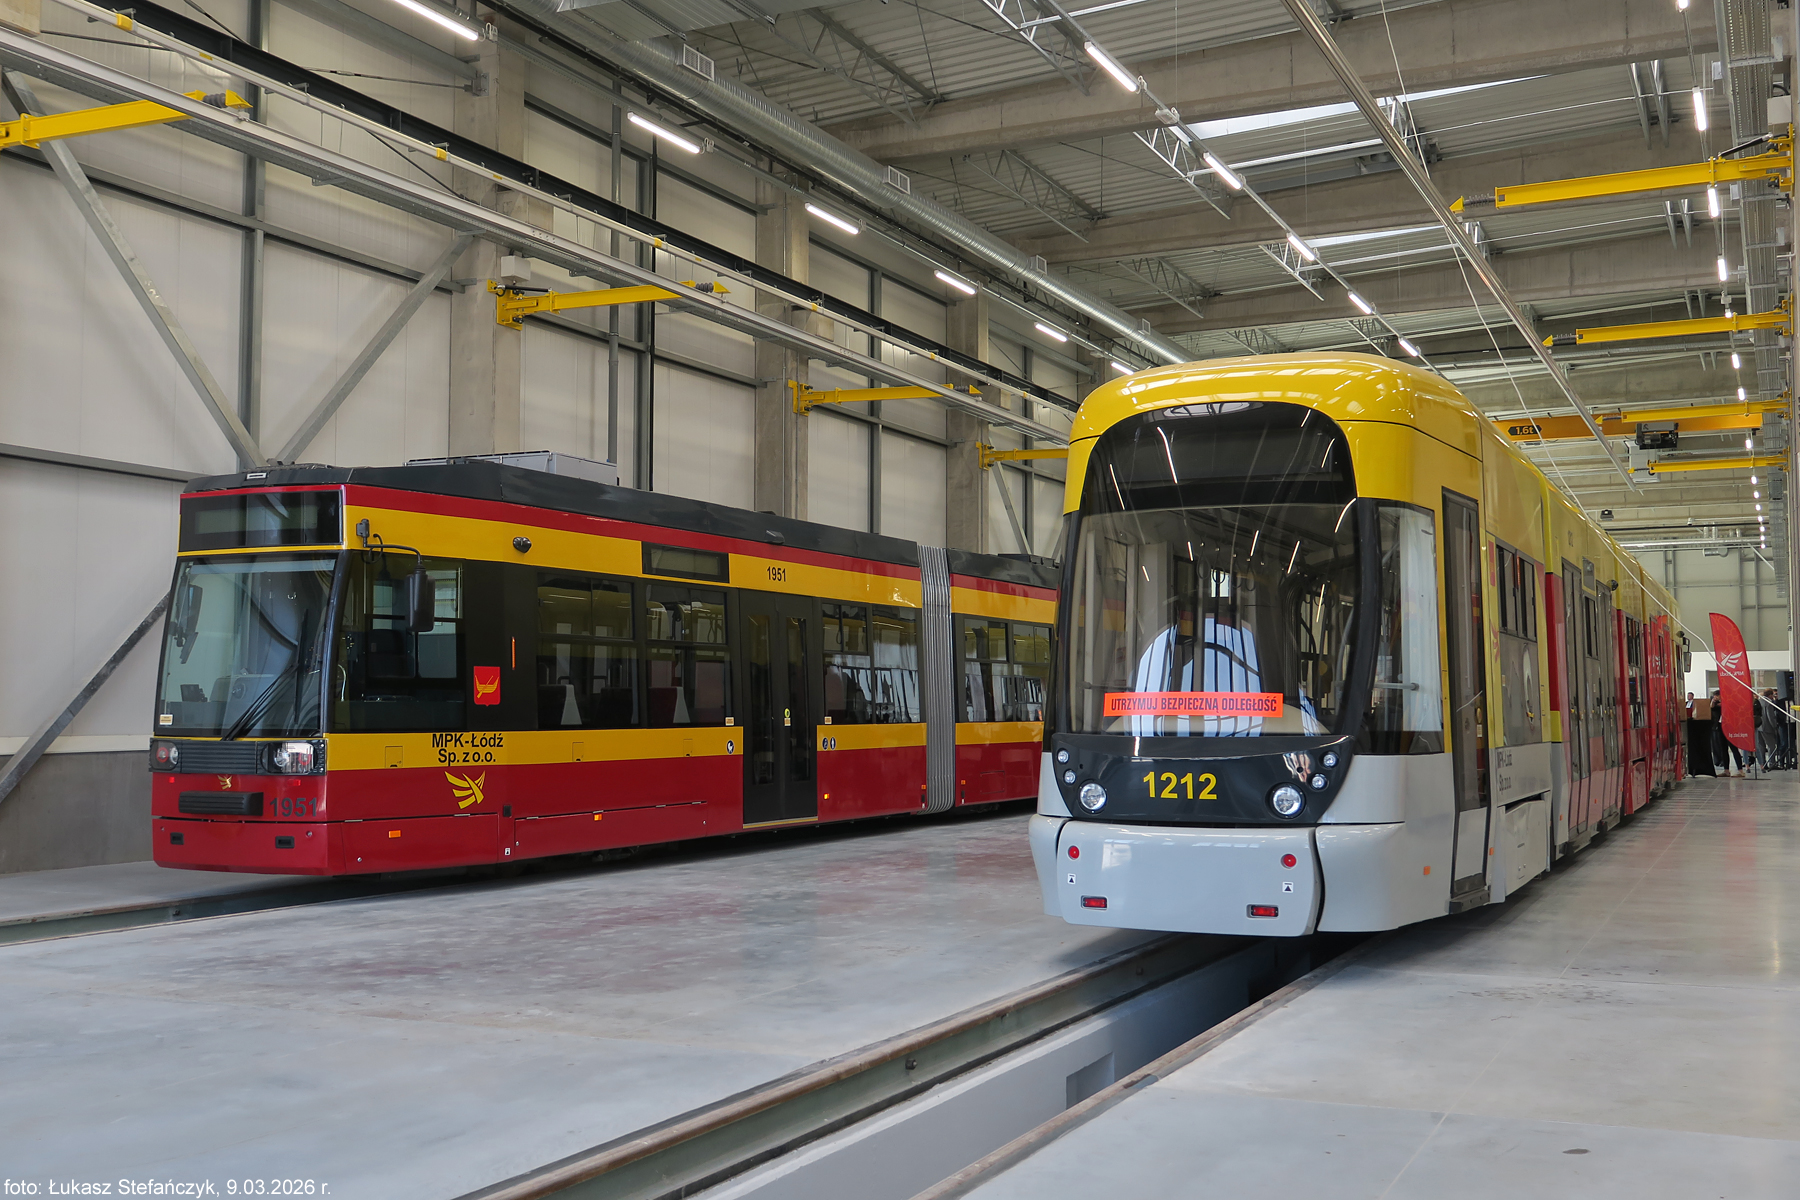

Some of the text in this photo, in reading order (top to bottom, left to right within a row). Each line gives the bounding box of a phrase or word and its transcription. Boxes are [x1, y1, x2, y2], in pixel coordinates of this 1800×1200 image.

[1515, 426, 1534, 435] 1,6t
[766, 566, 786, 582] 1951
[1111, 695, 1277, 714] UTRZYMUJ BEZPIECZNĄ ODLEGŁOŚĆ
[432, 733, 504, 748] MPK-Łódź
[438, 748, 460, 767] Sp.
[1143, 771, 1217, 800] 1212
[270, 797, 317, 817] 1951
